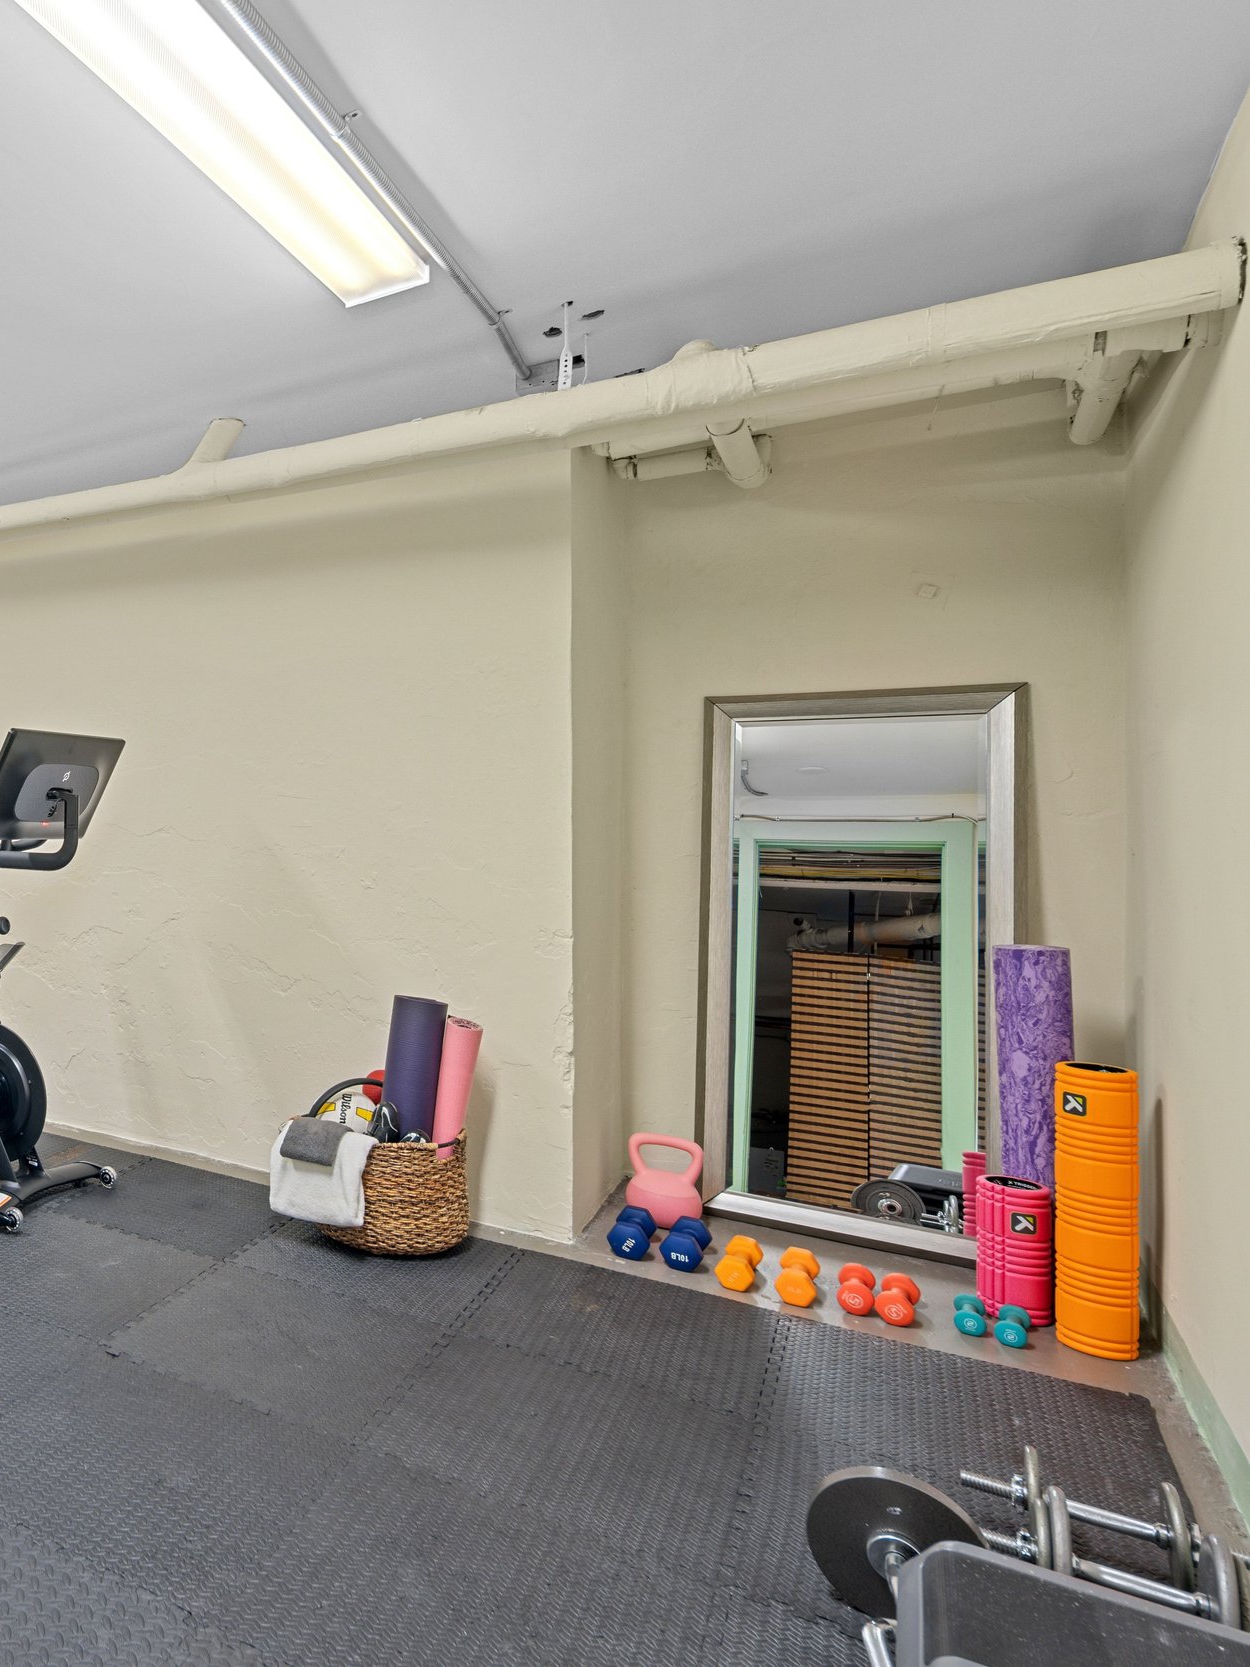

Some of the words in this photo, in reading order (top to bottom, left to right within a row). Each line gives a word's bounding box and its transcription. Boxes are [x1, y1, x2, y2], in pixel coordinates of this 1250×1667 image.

[339, 1093, 353, 1124] Wilson
[621, 1237, 636, 1253] 10LB
[670, 1251, 689, 1263] 10LB
